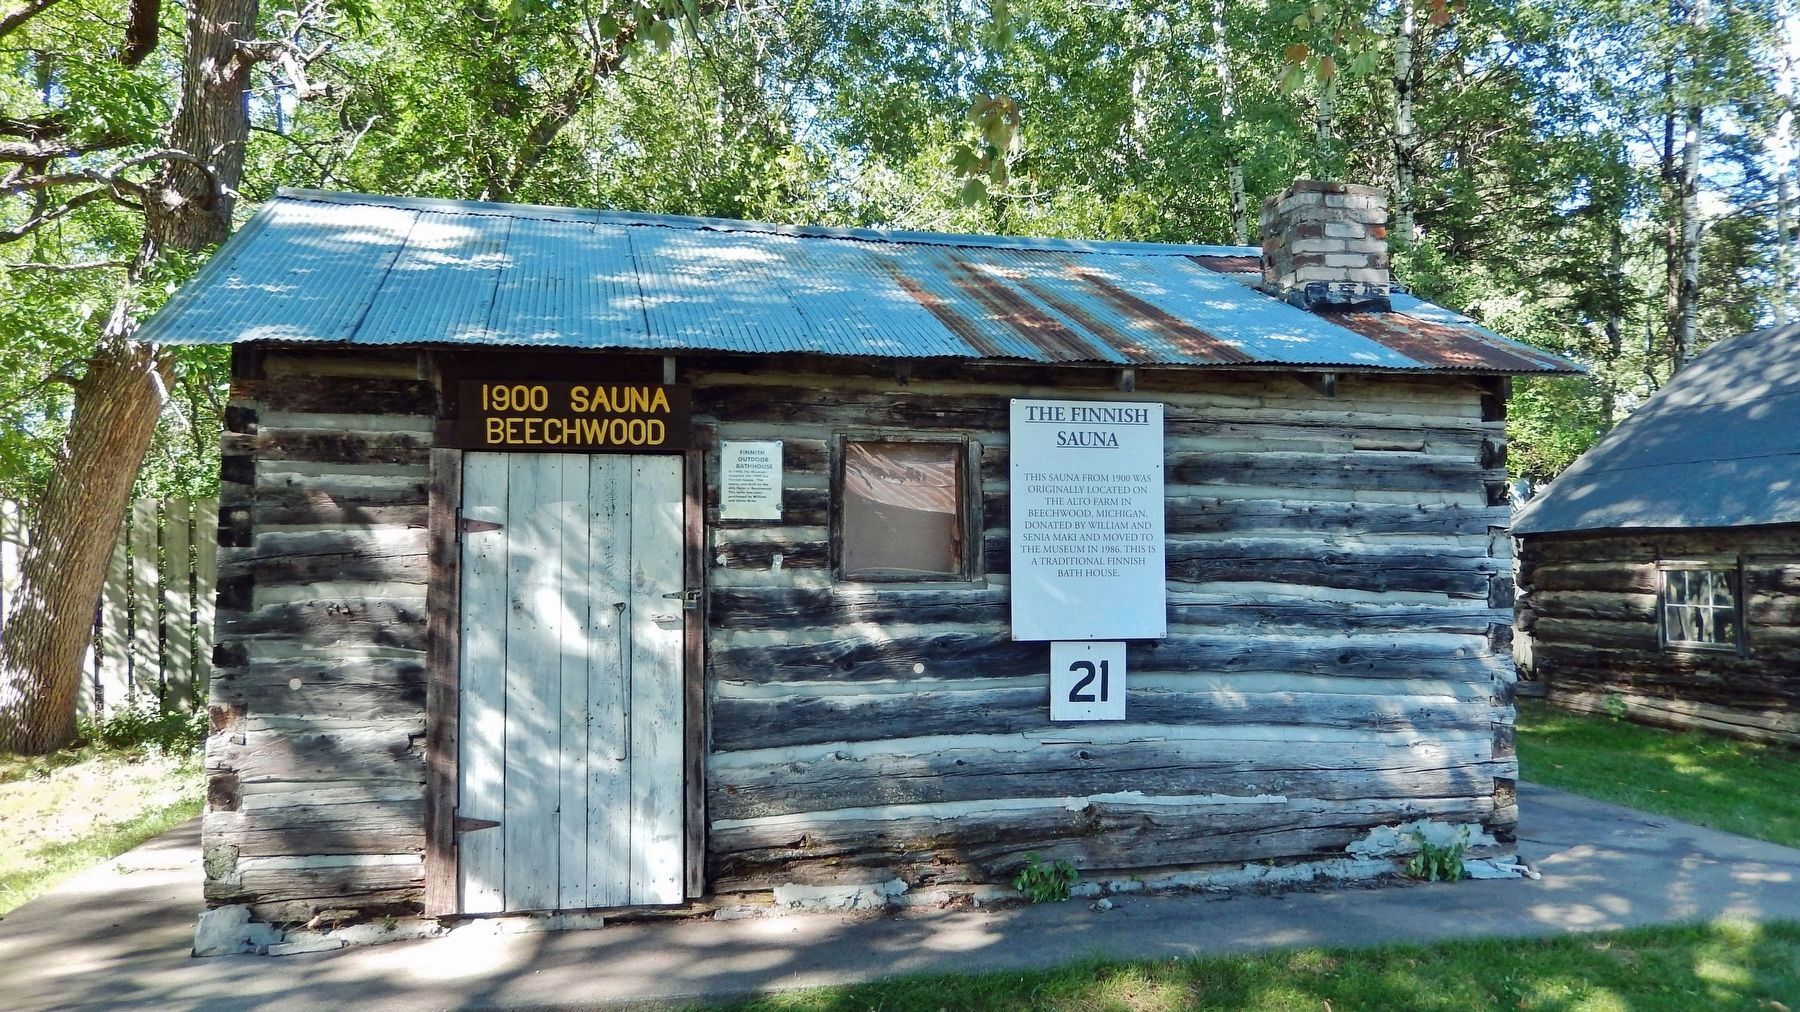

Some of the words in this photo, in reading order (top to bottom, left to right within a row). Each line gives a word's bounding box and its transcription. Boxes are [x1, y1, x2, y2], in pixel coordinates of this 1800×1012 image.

[482, 384, 548, 412] 1900
[571, 386, 671, 413] SAUNA
[1025, 406, 1065, 421] THE
[1071, 407, 1149, 423] FINNISH
[486, 417, 665, 445] BEECHWOOD
[1056, 430, 1119, 446] SAUNA
[1024, 472, 1047, 482] THIS
[1048, 473, 1080, 482] SAUNA
[1082, 473, 1109, 482] FROM
[1112, 474, 1131, 482] 1900
[1132, 474, 1152, 482] WAS
[1027, 485, 1086, 494] ORIGINALLY
[1087, 485, 1131, 494] LOCATED
[1132, 486, 1148, 494] ON
[1045, 497, 1065, 505] THE
[1066, 497, 1091, 506] ALTO
[1093, 497, 1119, 506] FARM
[1121, 497, 1132, 506] IN
[1028, 508, 1094, 518] BEECHWOOD,
[1096, 509, 1148, 518] MICHIGAN,
[1024, 521, 1072, 529] DONATED
[1074, 521, 1087, 529] BY
[1088, 521, 1129, 530] WILLIAM
[1131, 521, 1152, 530] AND
[1022, 533, 1051, 541] SENIA
[1052, 533, 1077, 541] MAKI
[1079, 533, 1101, 541] AND
[1102, 533, 1138, 542] MOVED
[1139, 533, 1154, 542] TO
[1020, 545, 1041, 554] THE
[1043, 545, 1085, 554] MUSEUM
[1087, 545, 1098, 554] IN
[1101, 545, 1122, 553] 1986.
[1123, 545, 1146, 553] THIS
[1148, 545, 1156, 553] IS
[1031, 557, 1038, 565] A
[1039, 557, 1105, 565] TRADITIONAL
[1107, 556, 1146, 565] FINNISH
[1057, 569, 1083, 577] BATH
[1085, 569, 1120, 577] HOUSE.
[1068, 660, 1109, 703] 21
